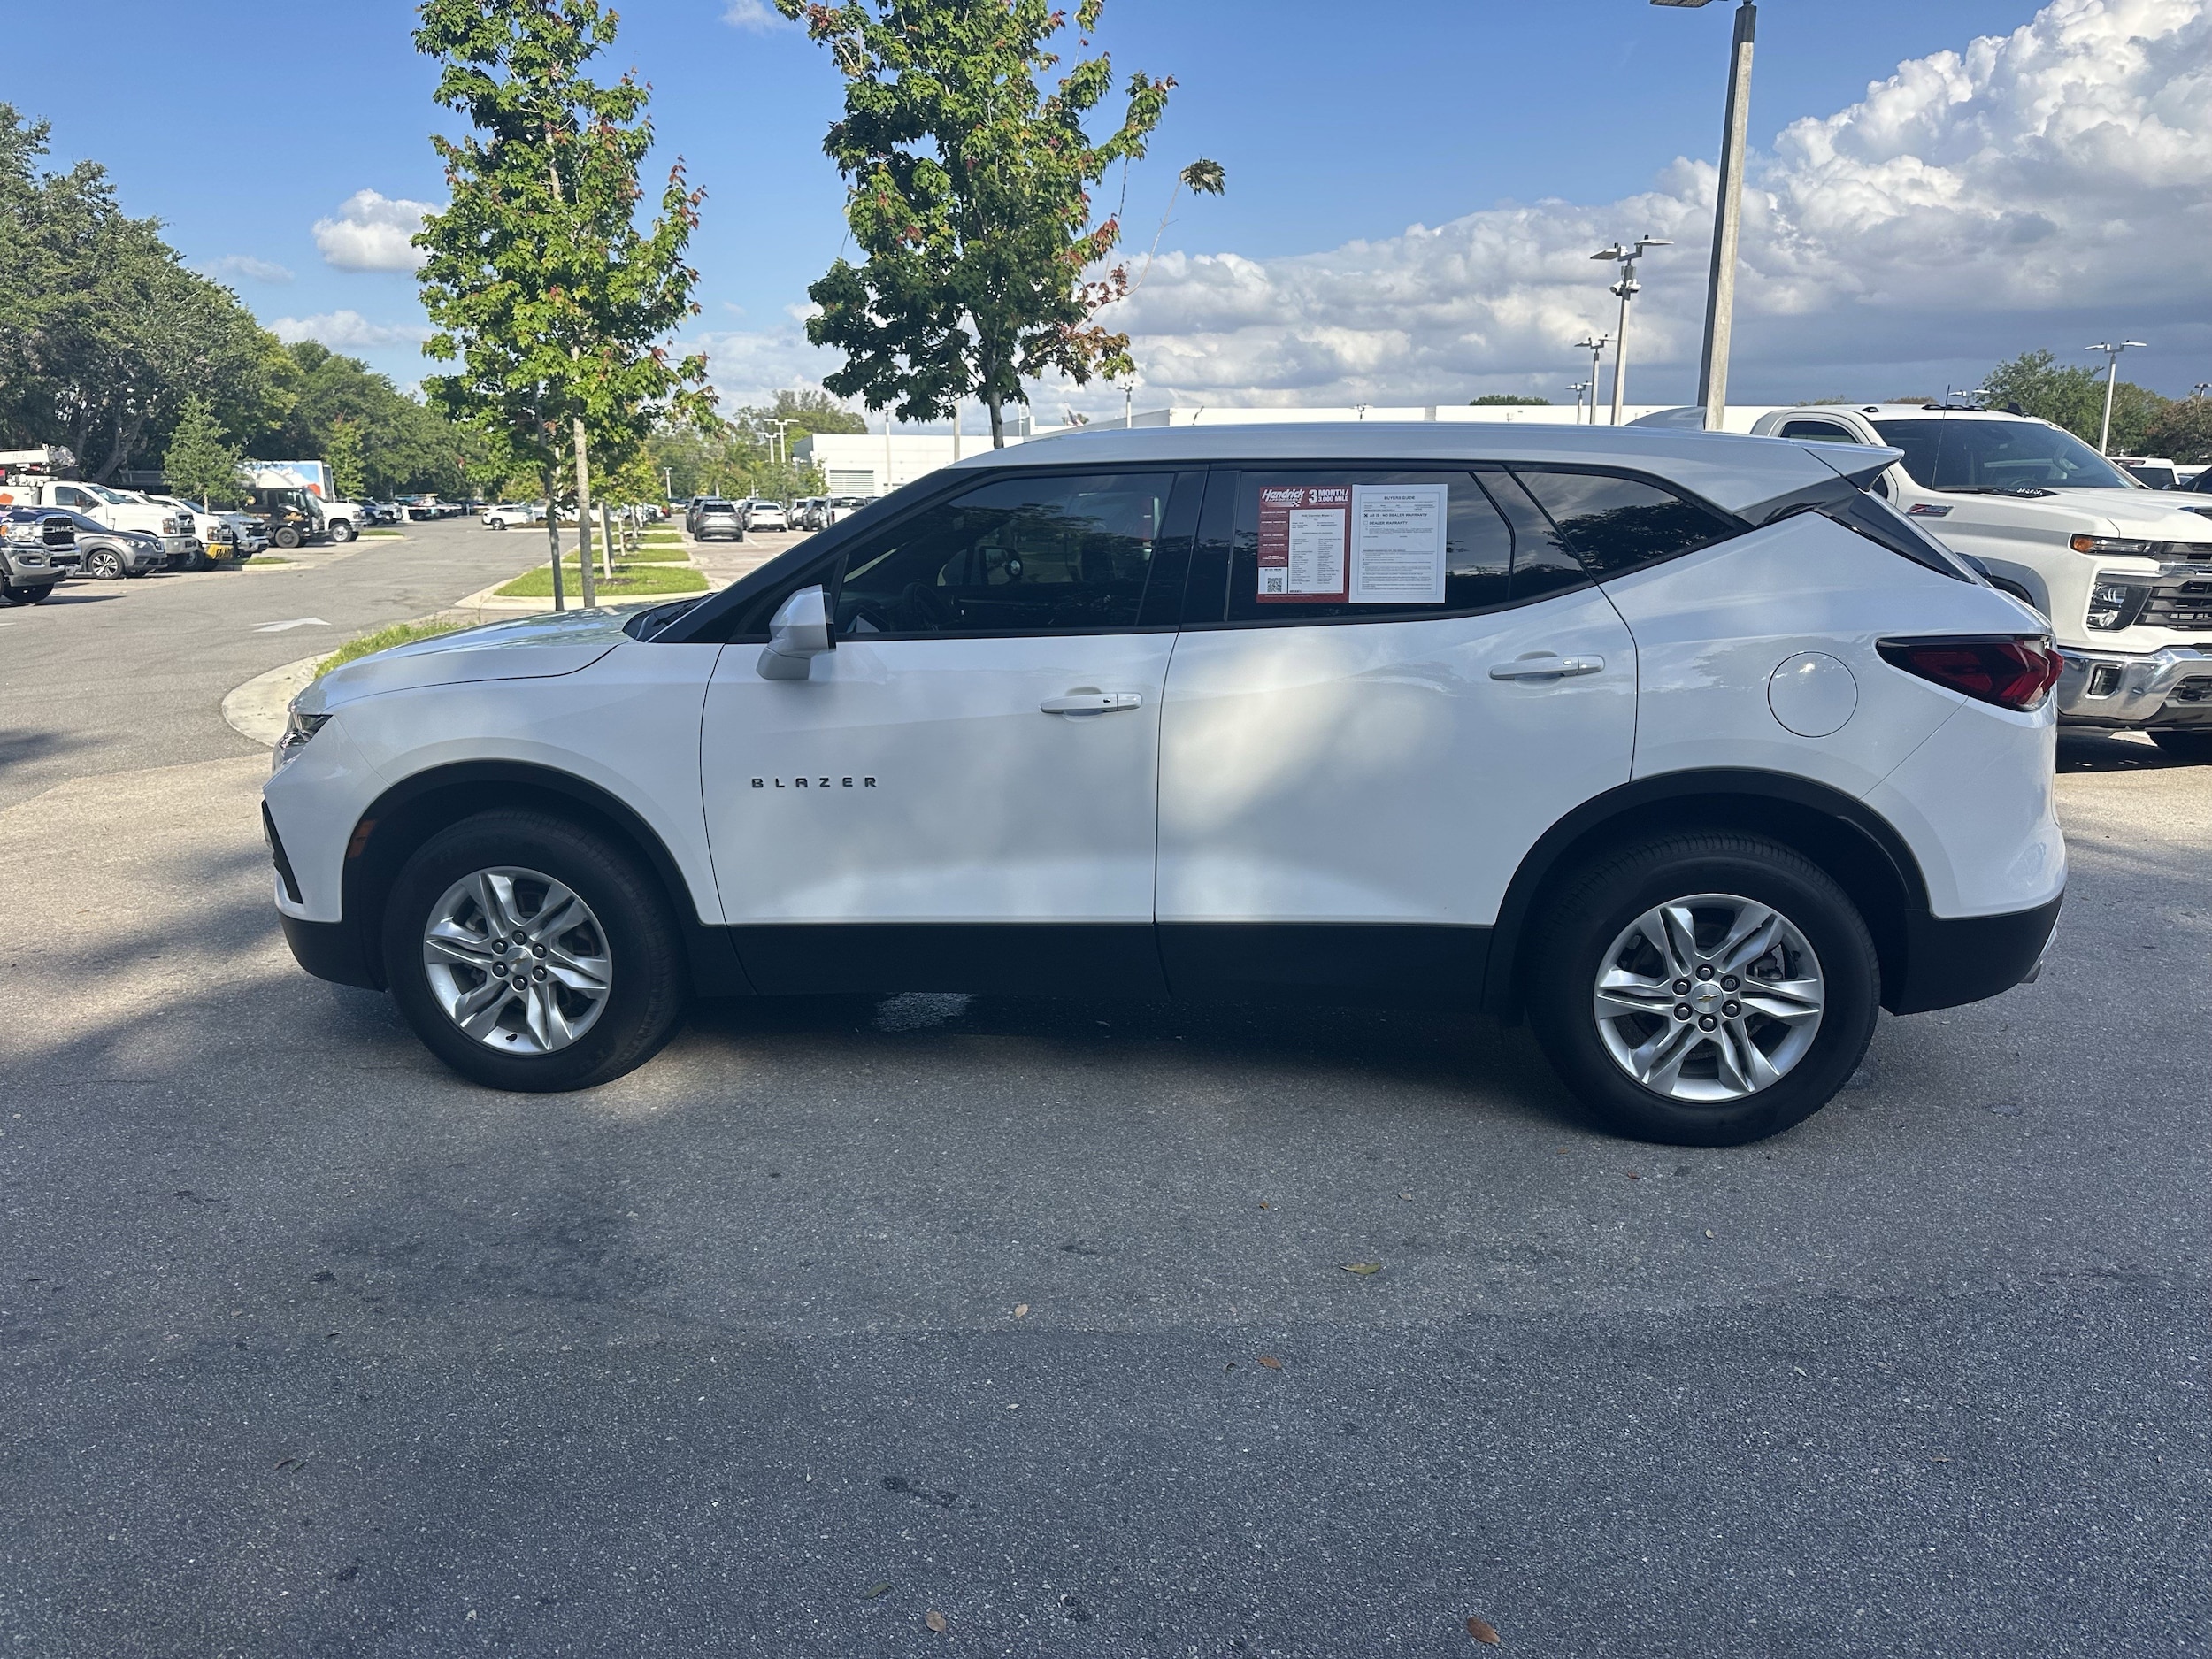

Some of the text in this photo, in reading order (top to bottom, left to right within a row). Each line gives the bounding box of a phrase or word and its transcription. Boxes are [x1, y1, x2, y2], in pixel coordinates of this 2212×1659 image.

[1261, 488, 1305, 502] Hendrick
[1308, 489, 1318, 503] 3
[751, 777, 877, 788] BLAZER
